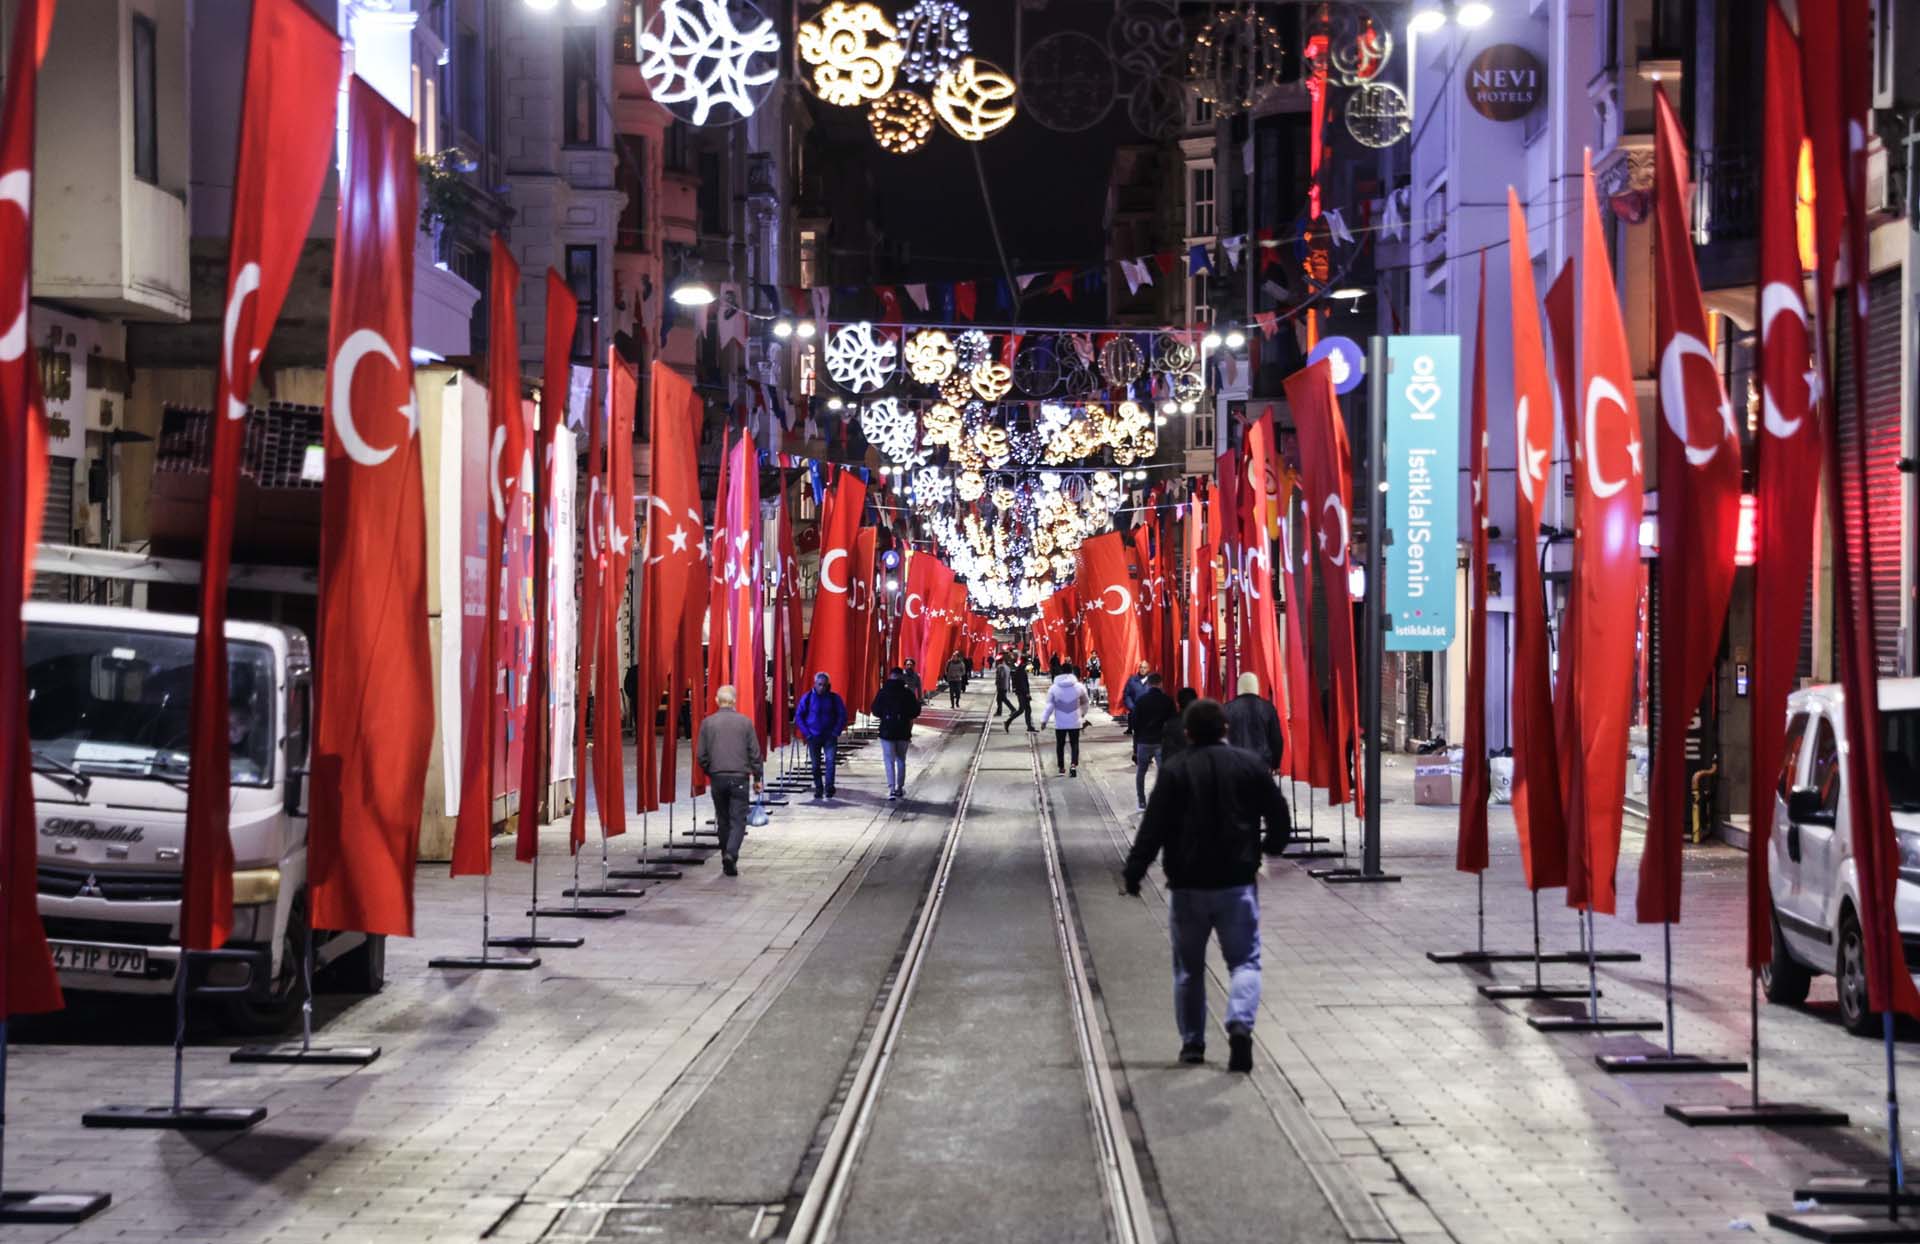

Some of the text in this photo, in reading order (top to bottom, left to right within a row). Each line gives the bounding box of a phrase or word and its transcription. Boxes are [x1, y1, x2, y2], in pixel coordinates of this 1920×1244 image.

[1473, 69, 1536, 88] NEVI
[1477, 92, 1532, 102] HOTELS
[108, 950, 142, 971] 070
